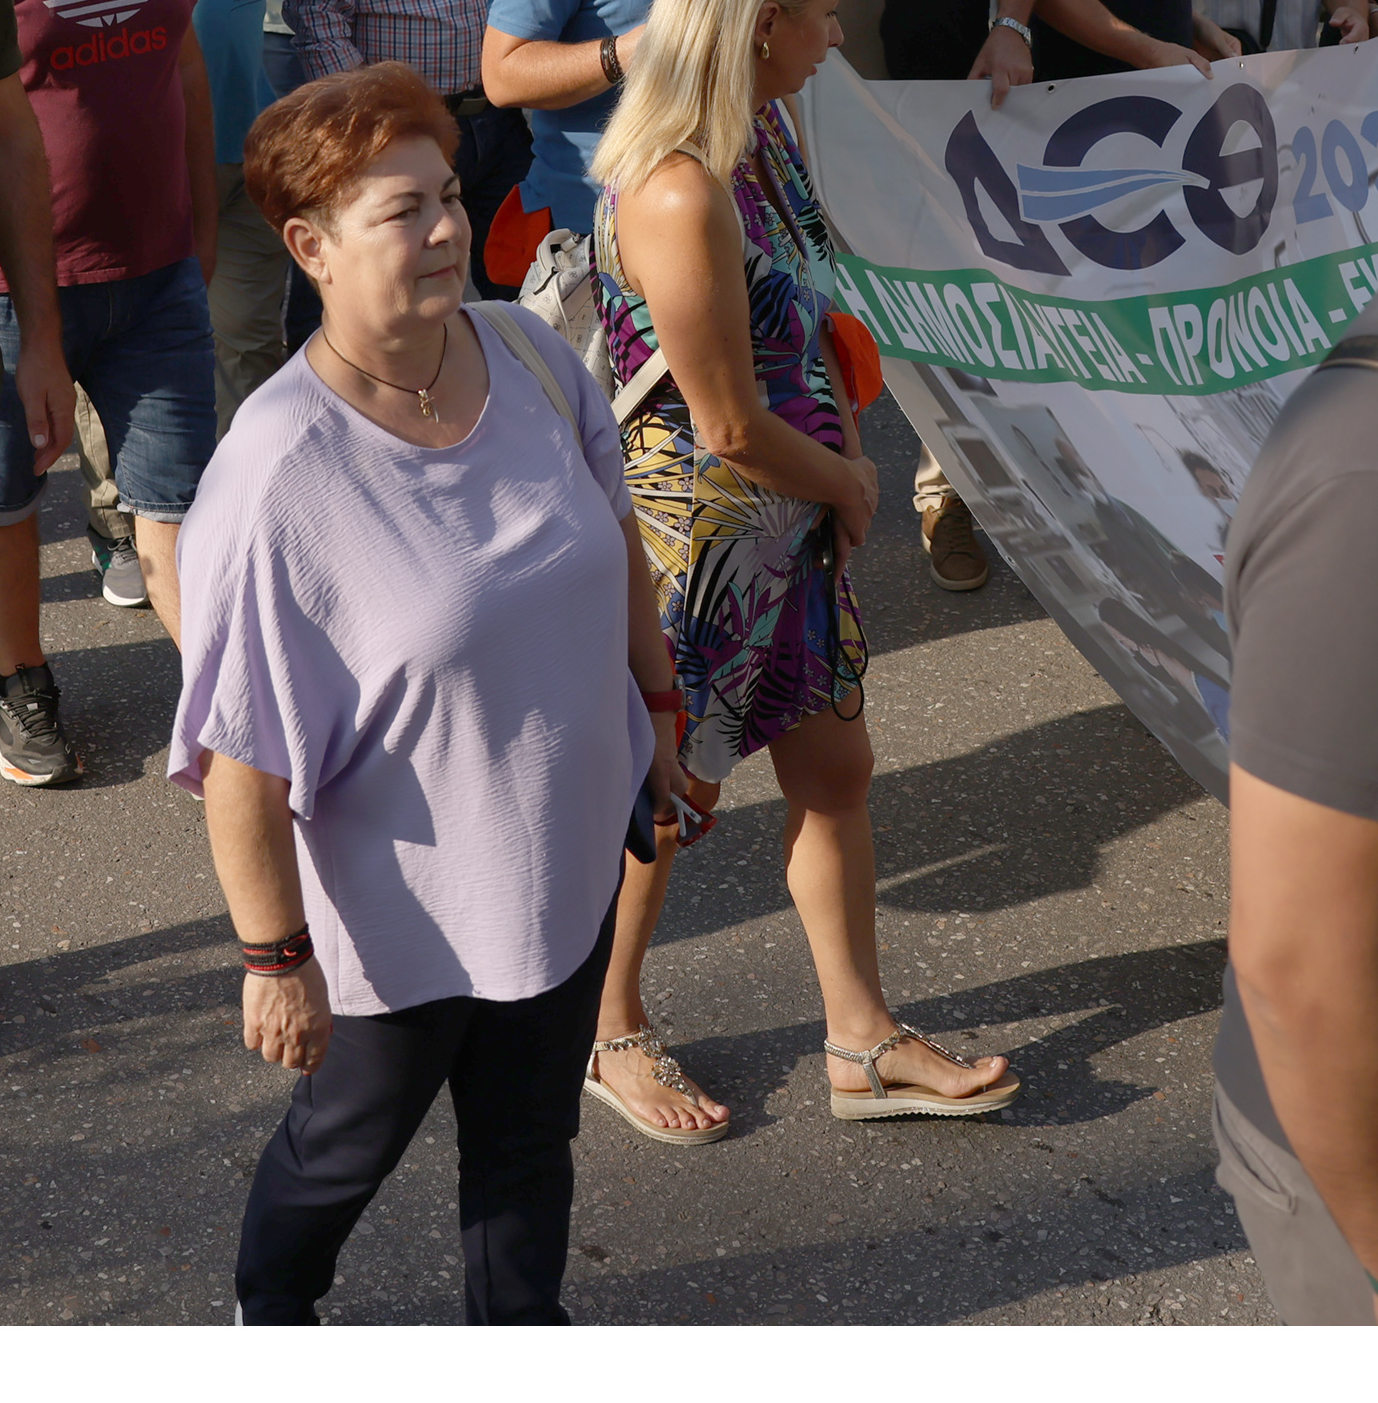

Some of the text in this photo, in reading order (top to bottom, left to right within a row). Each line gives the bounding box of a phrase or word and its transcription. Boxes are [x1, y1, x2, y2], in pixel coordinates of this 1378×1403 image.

[50, 26, 168, 71] adidas
[865, 269, 1065, 371] ΔΗΜΟΣΙΑ
[1022, 299, 1148, 384] ΥΓΕΙΑ
[1148, 278, 1333, 386] ΠΡΟΝΟΙΑ
